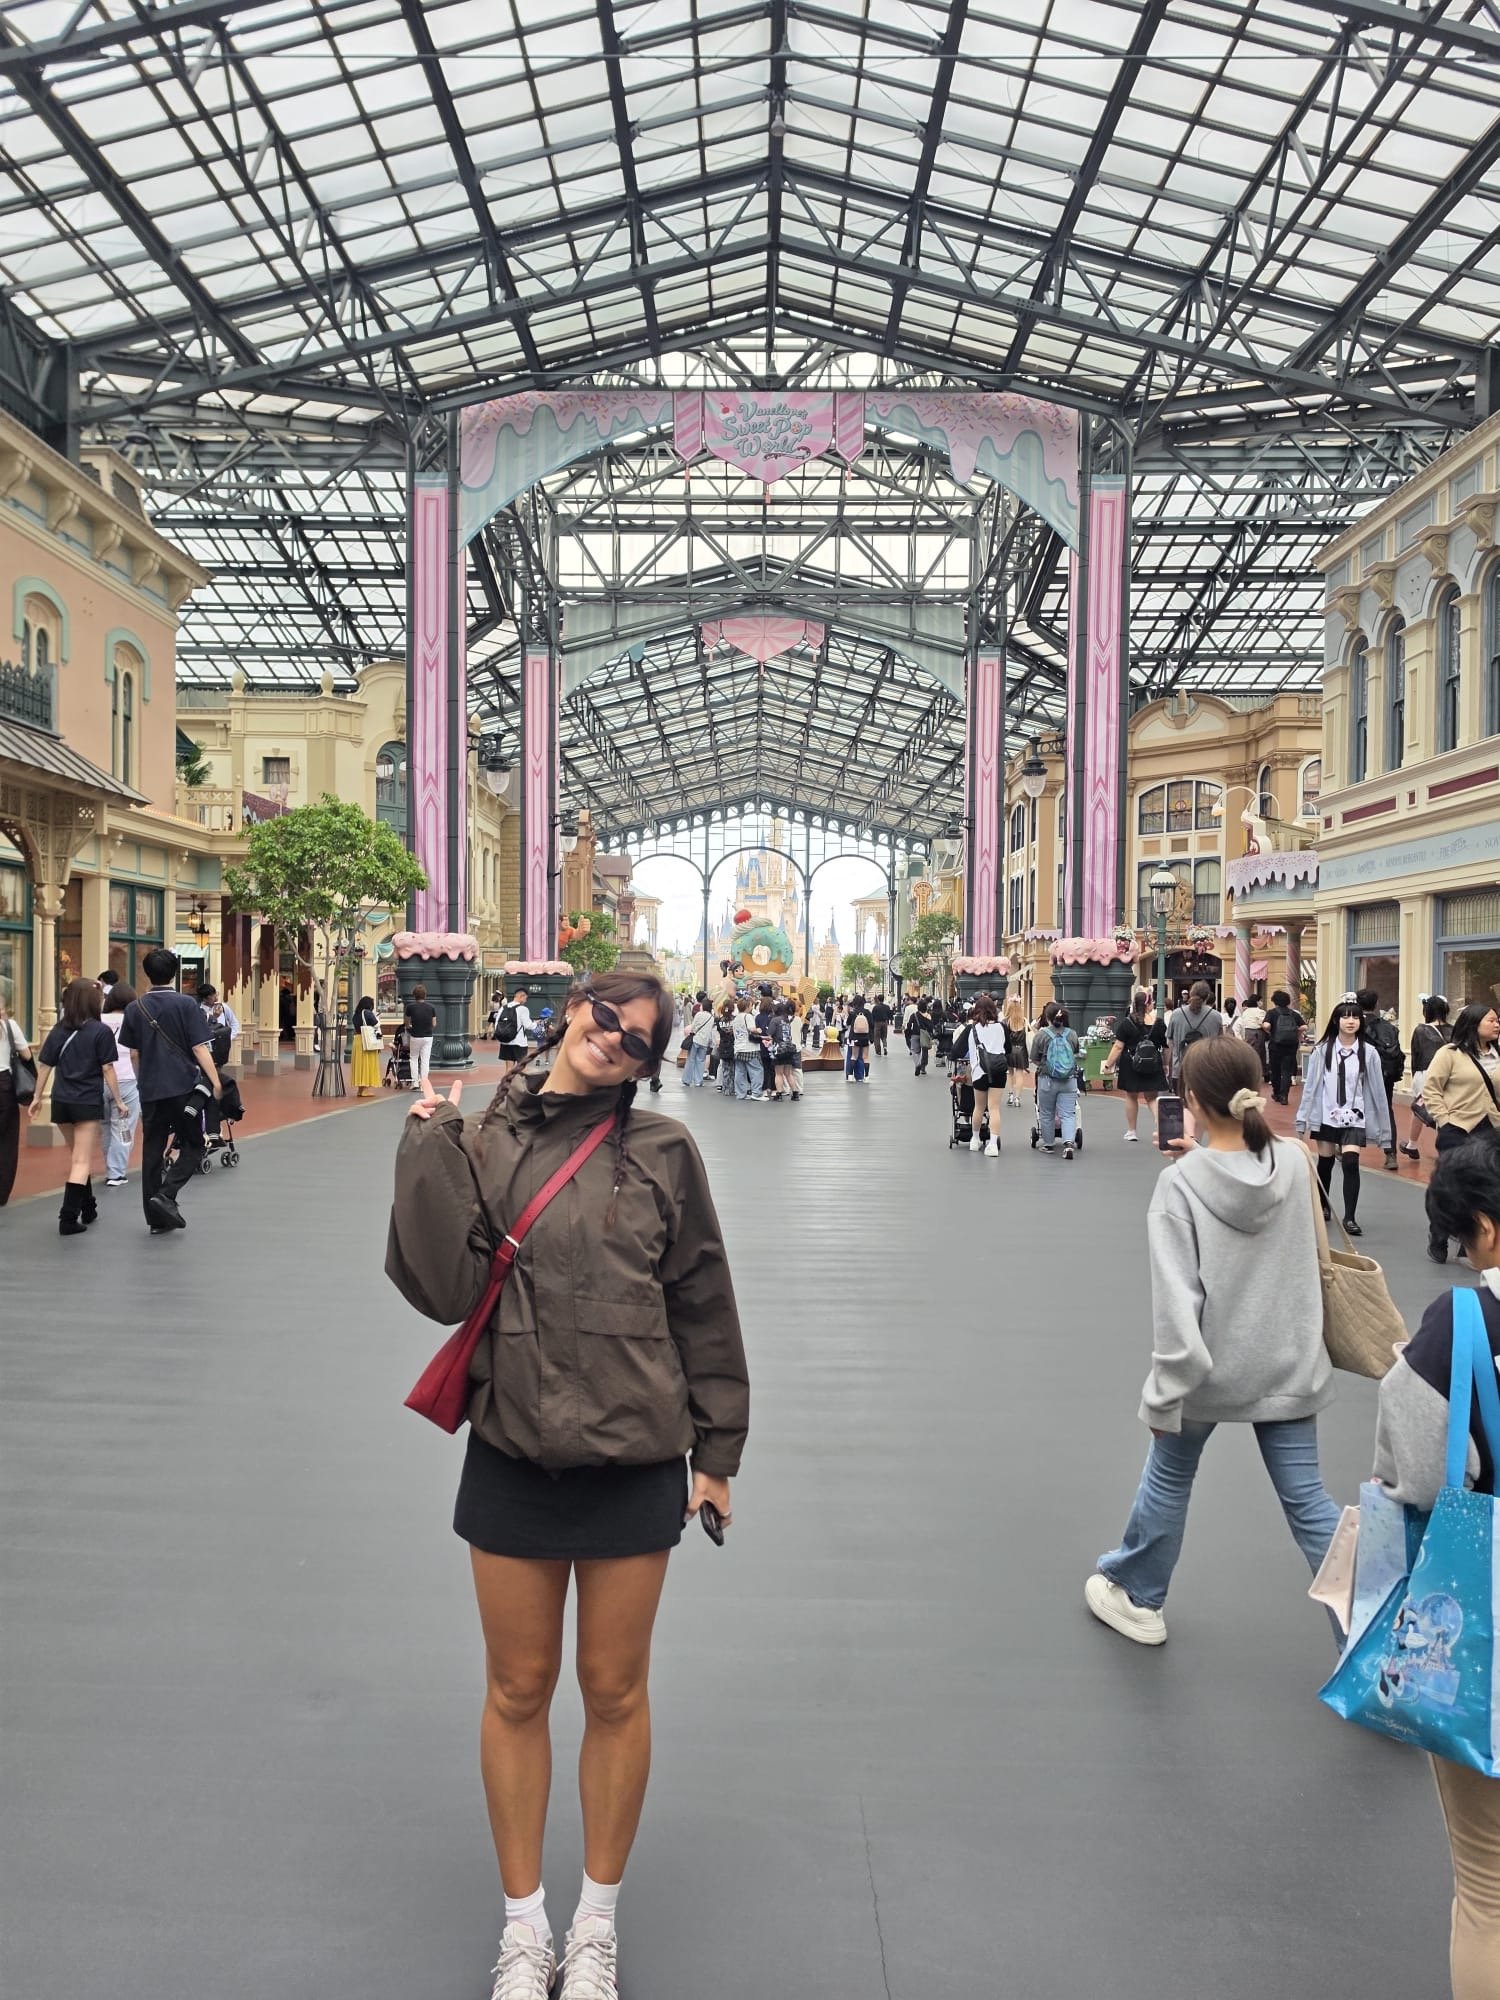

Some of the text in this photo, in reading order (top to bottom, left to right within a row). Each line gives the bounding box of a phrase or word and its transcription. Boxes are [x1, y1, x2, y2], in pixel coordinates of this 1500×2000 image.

[721, 415, 812, 442] Sweet Pop
[734, 435, 799, 458] World
